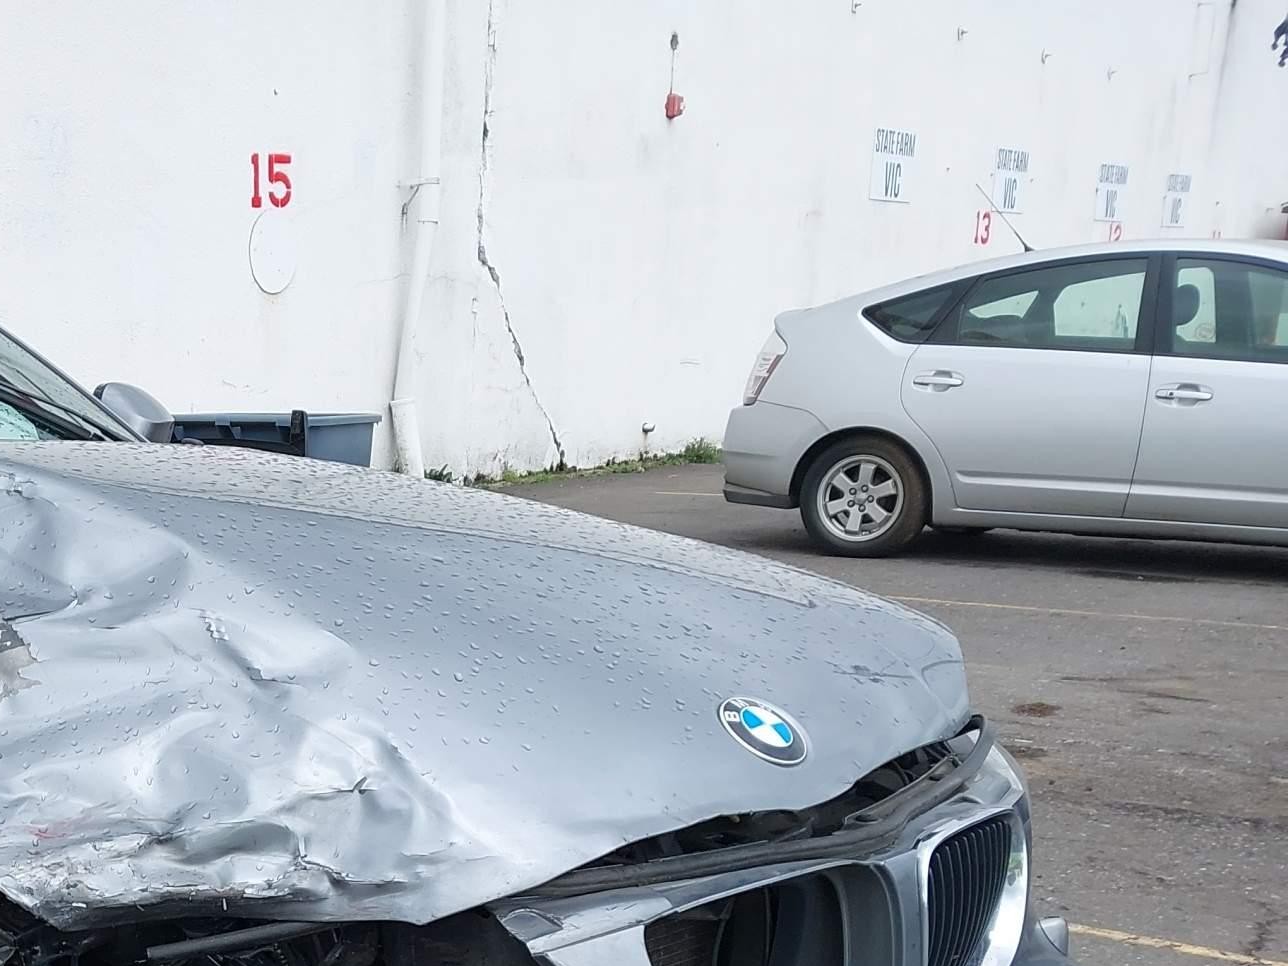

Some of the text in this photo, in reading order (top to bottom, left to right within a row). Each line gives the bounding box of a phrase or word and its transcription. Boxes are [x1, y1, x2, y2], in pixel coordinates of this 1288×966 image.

[875, 128, 917, 157] STATE FARM
[997, 148, 1029, 172] STATE FARM
[251, 153, 291, 208] 15
[884, 161, 902, 198] VIC
[1003, 178, 1018, 209] VIC
[974, 210, 992, 245] 13
